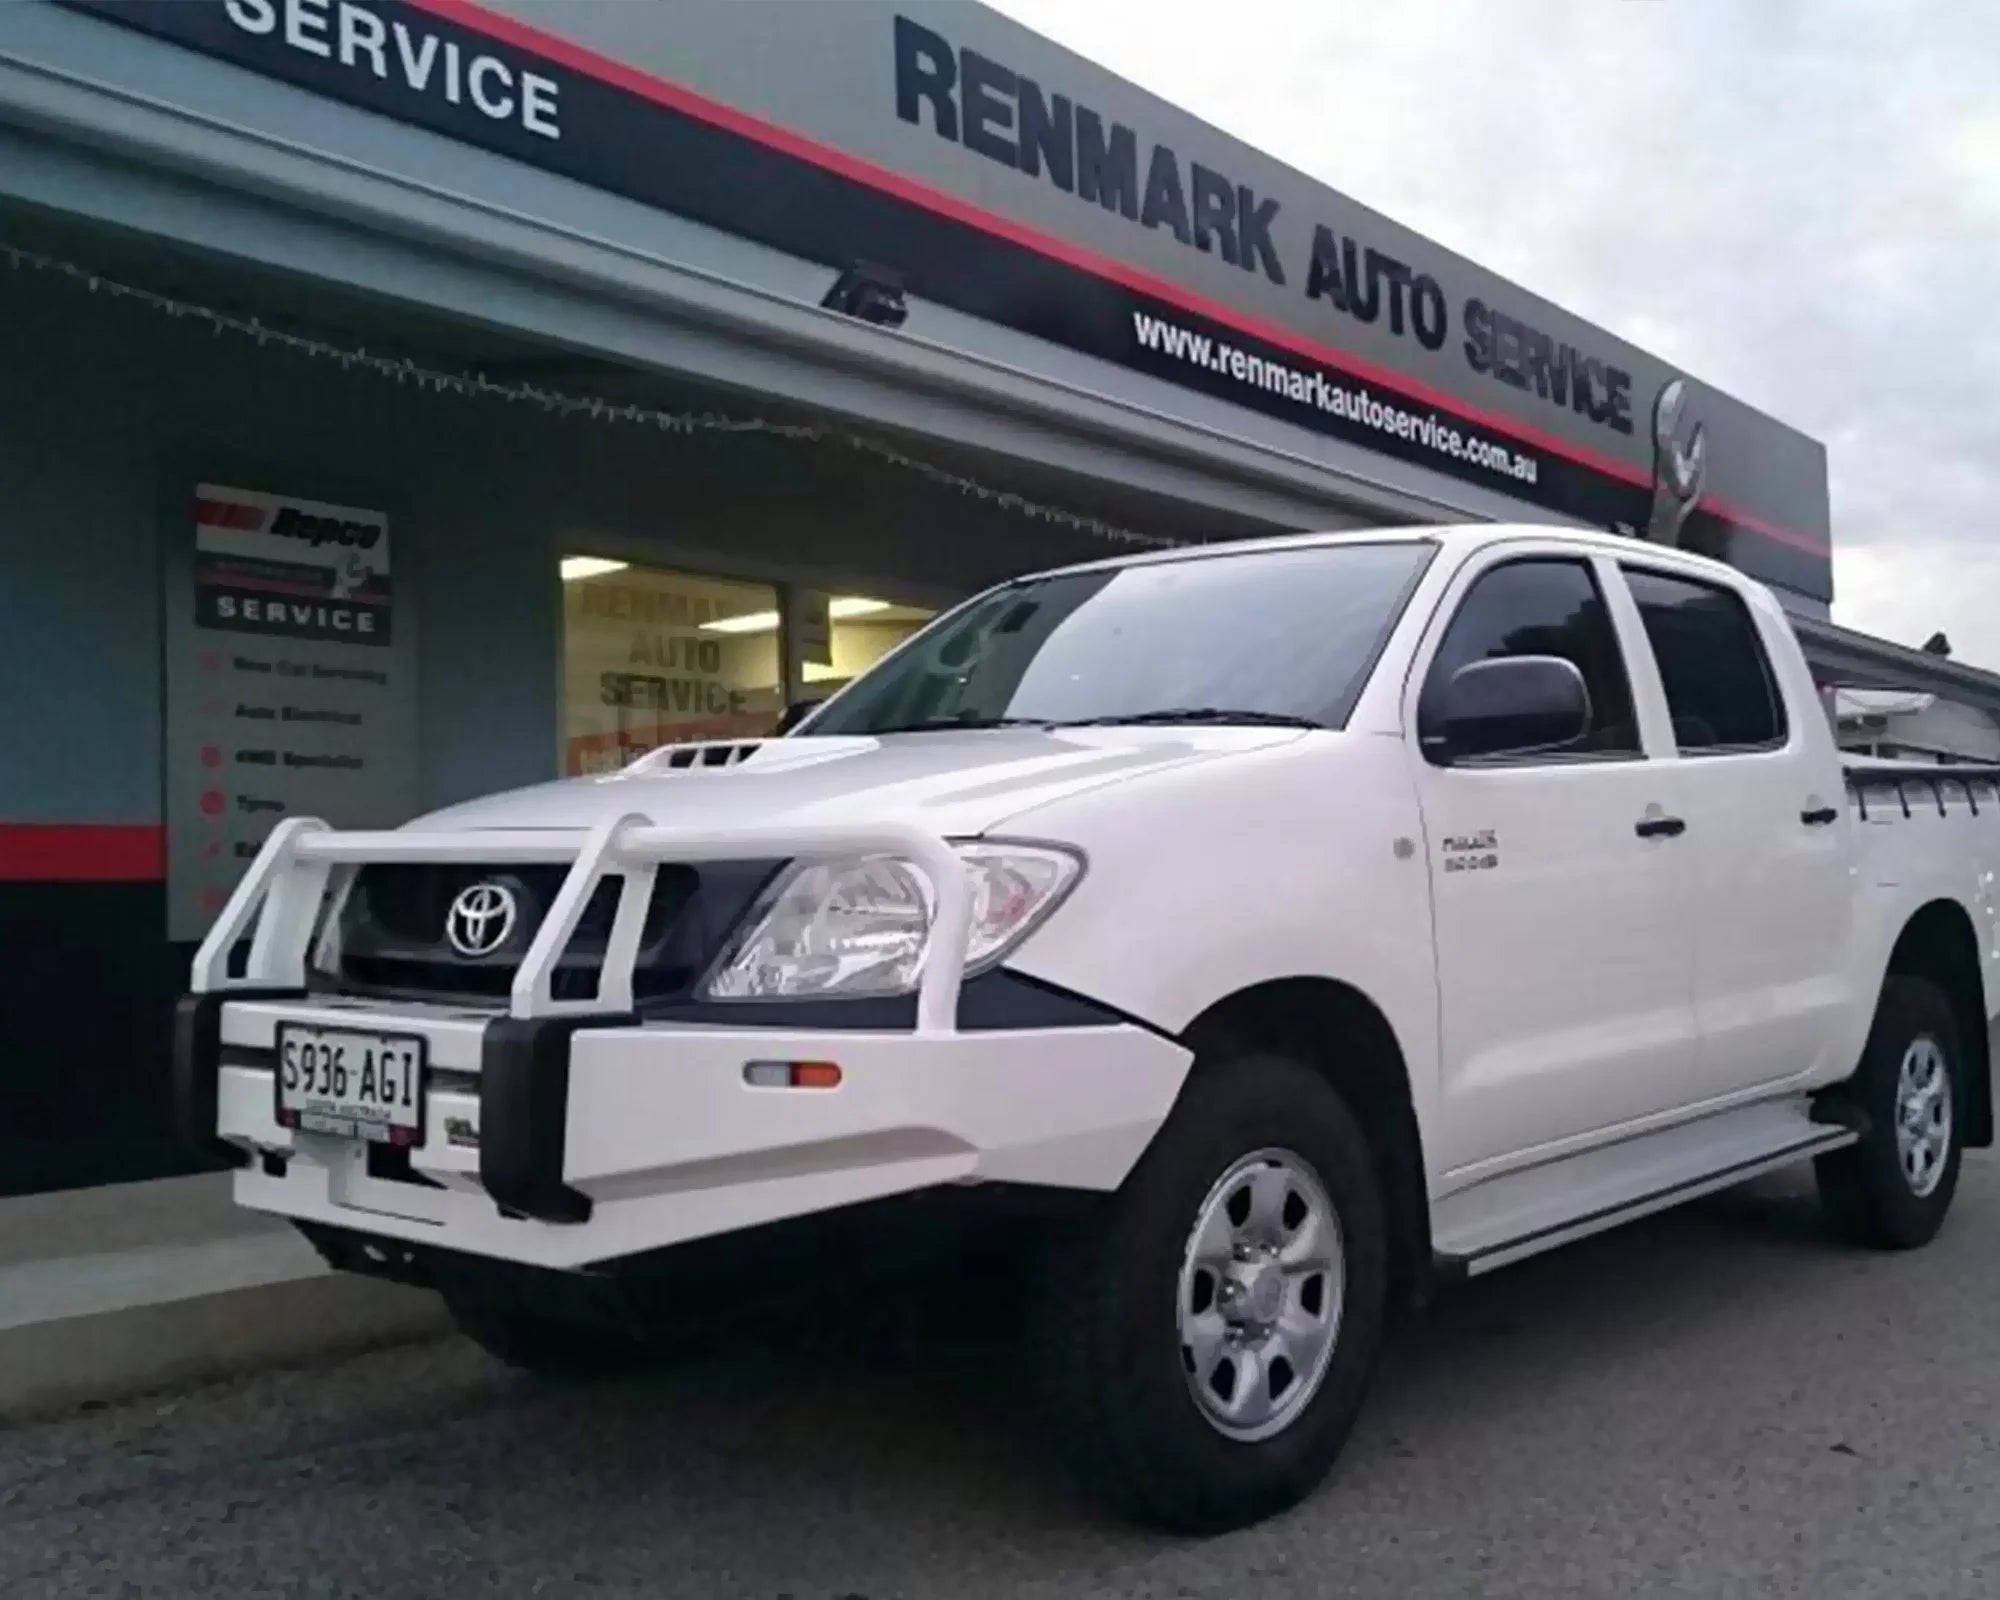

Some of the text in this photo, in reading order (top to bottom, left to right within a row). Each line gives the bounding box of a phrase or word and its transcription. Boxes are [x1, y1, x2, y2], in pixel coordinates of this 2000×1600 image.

[893, 15, 1634, 435] RENMARK AUTO SERVICE
[1133, 311, 1538, 484] www.renmarkautoservice.com.au
[217, 594, 376, 634] SERVICE
[629, 631, 721, 674] AUTO
[600, 671, 748, 716] SERVICE
